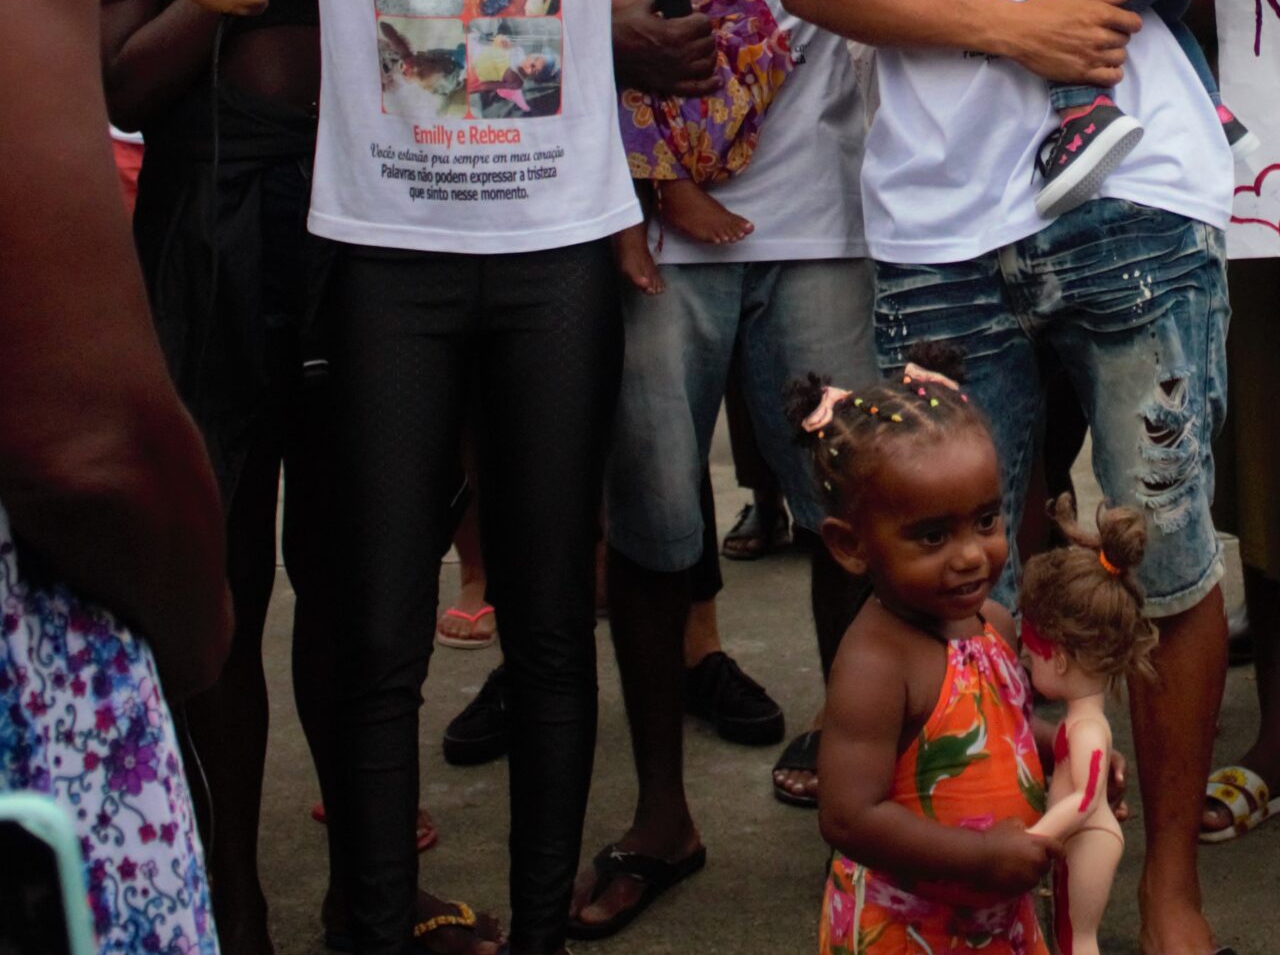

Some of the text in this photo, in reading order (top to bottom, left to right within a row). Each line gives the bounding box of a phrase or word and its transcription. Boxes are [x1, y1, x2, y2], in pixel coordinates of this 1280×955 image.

[413, 126, 520, 148] Emilly e Rebeca
[452, 152, 490, 168] sempre
[492, 152, 508, 163] em
[509, 152, 531, 163] meu
[381, 163, 557, 186] Palavras não podem expressar a tristeza
[409, 185, 529, 202] que sinto nesse momento.
